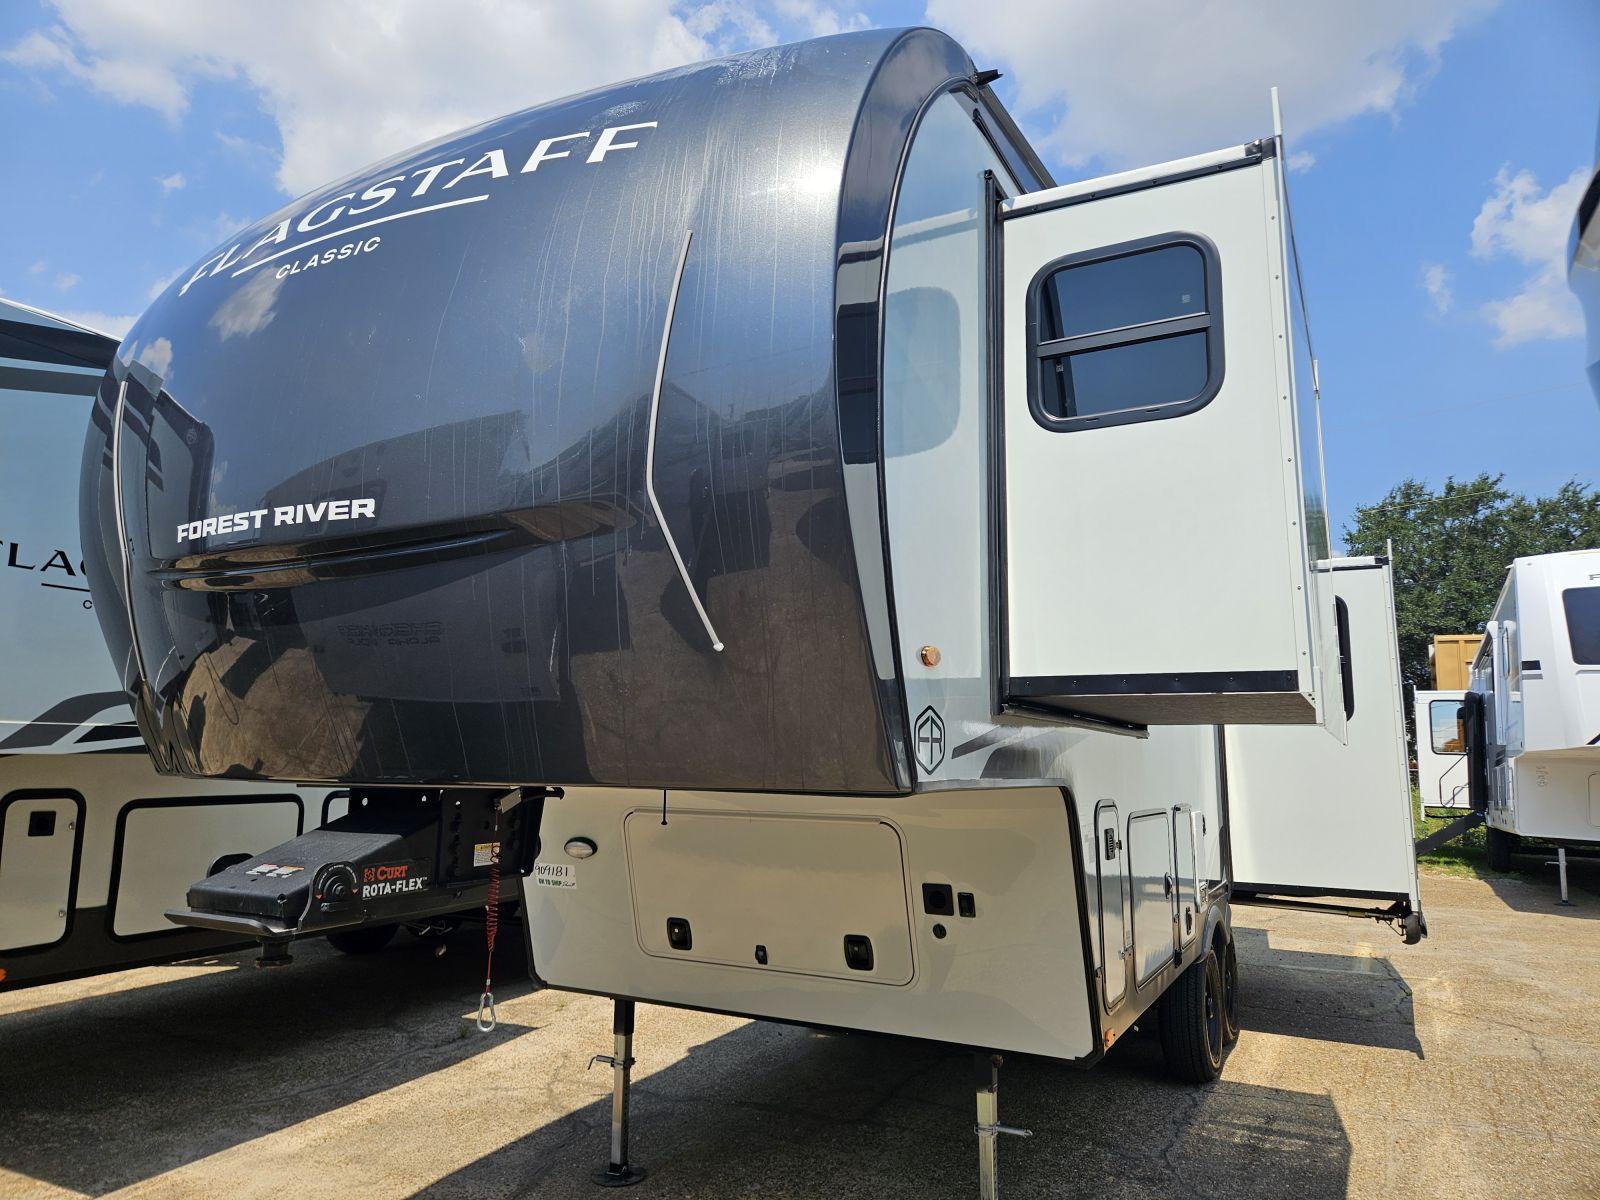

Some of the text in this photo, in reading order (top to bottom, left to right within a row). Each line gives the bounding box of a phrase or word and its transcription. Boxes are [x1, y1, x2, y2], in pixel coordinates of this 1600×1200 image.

[178, 121, 659, 297] FLAGSTAFF
[275, 236, 381, 279] CLASSIC
[176, 498, 376, 543] FOREST RIVER
[376, 865, 408, 880] CURT
[535, 864, 568, 877] 909181
[362, 877, 423, 898] ROTA-FLEX
